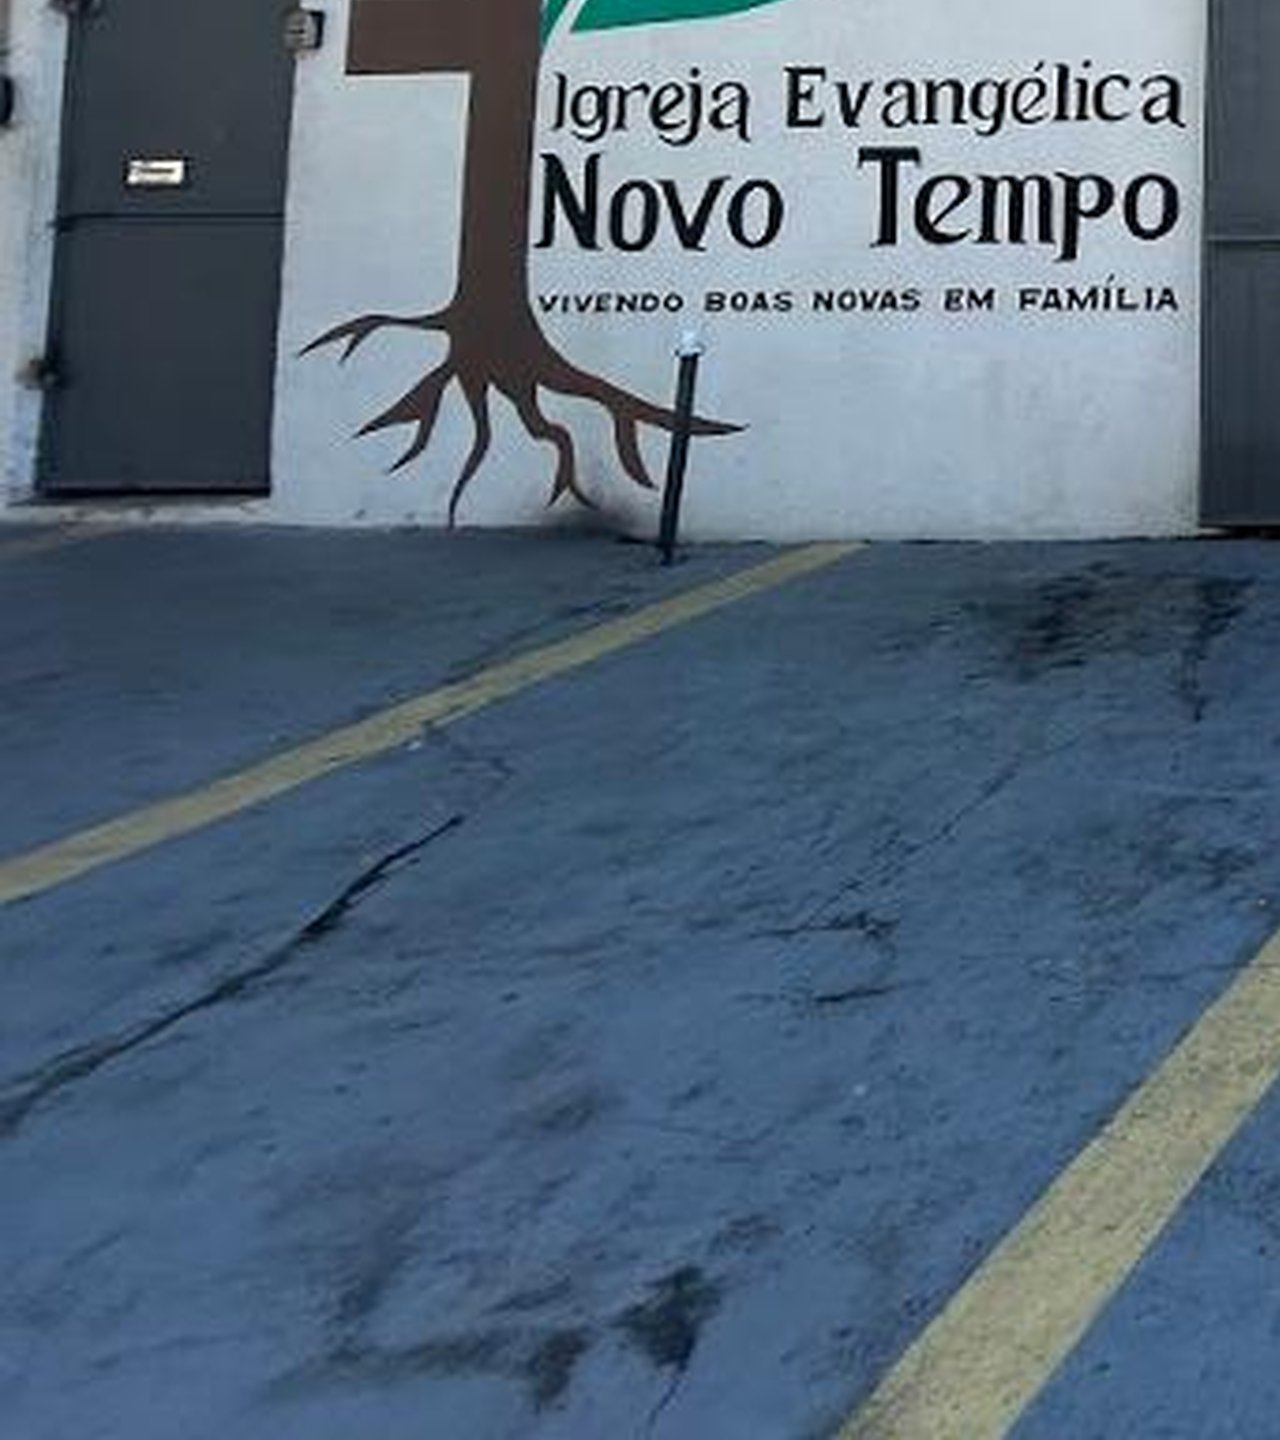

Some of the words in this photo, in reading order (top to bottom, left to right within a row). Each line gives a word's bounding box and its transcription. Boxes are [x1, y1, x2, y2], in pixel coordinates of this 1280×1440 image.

[551, 66, 752, 145] Igreja
[783, 59, 1186, 137] Evangélica
[857, 145, 1182, 261] Tempo
[538, 292, 685, 314] VIVENDO
[703, 291, 794, 313] BOAS
[812, 288, 922, 313] NOVAS
[943, 287, 996, 313] EM
[1017, 274, 1180, 313] FAMÍLIA
